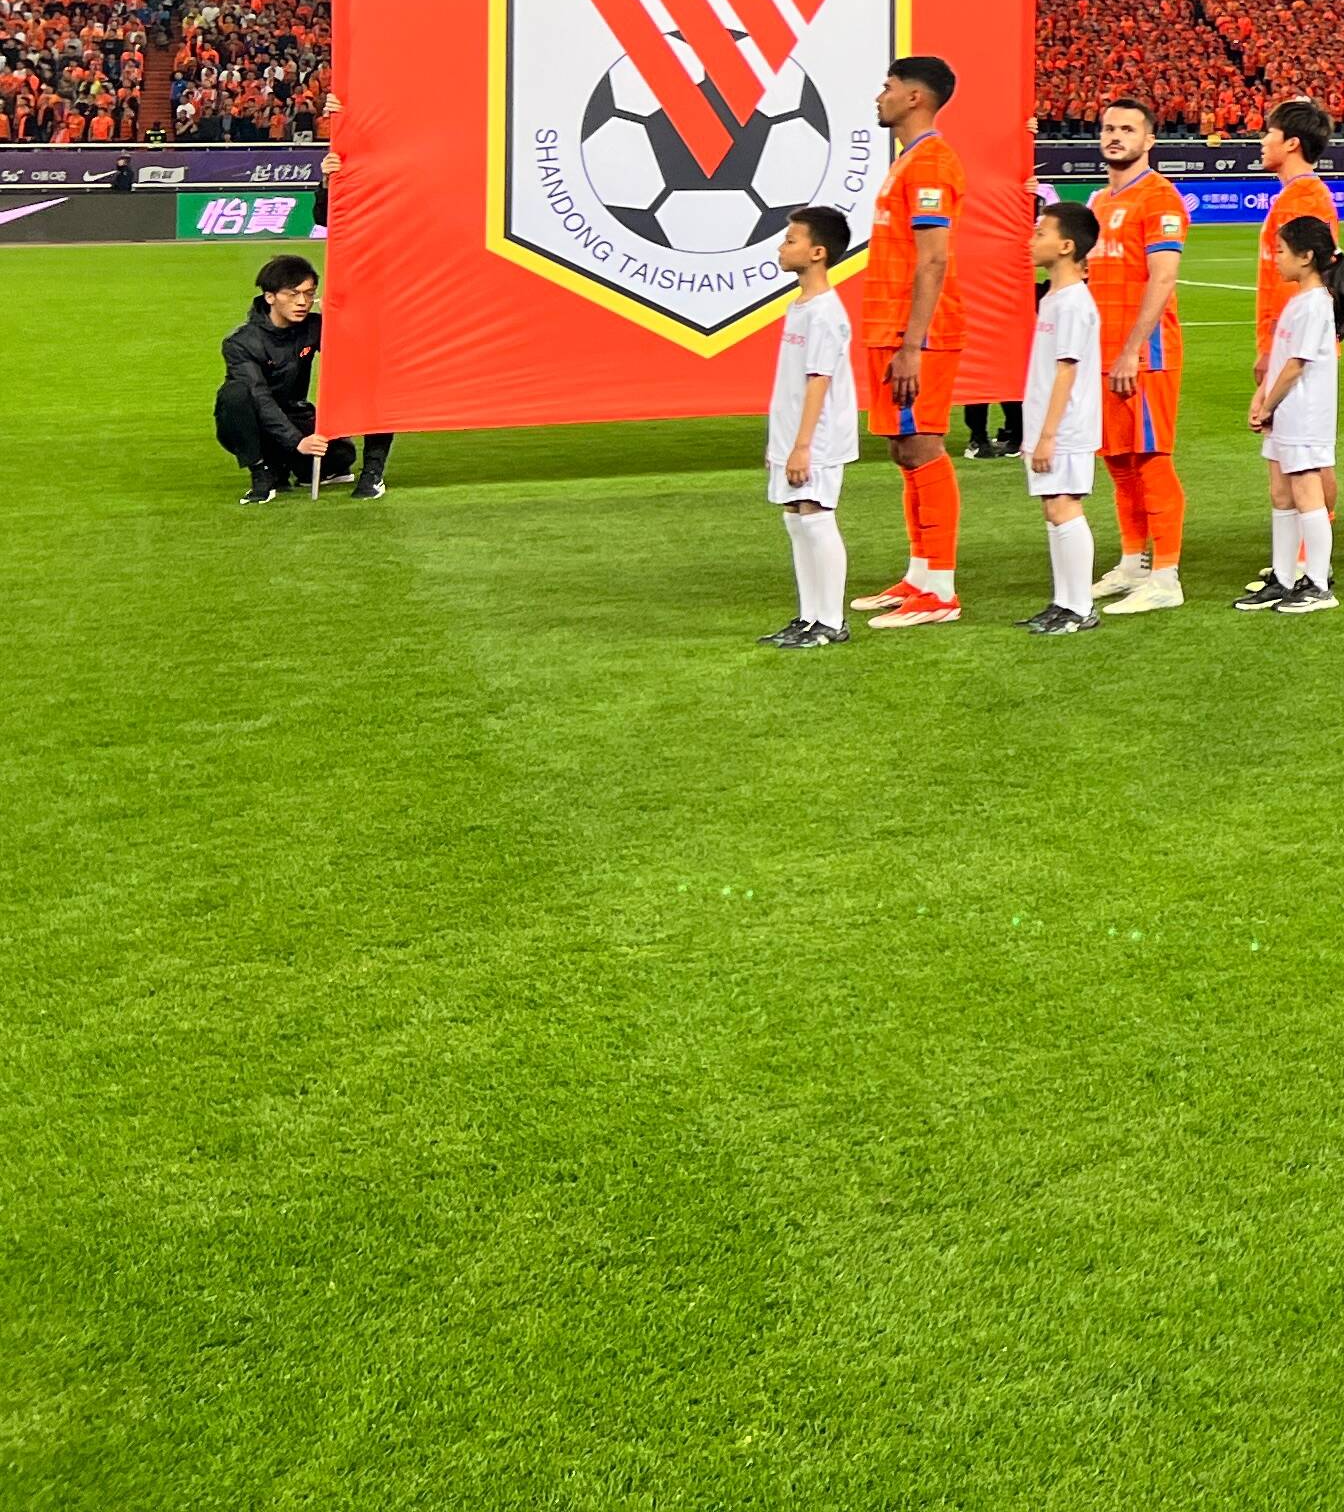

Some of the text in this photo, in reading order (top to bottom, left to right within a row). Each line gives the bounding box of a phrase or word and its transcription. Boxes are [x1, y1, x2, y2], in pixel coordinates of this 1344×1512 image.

[843, 127, 872, 192] CLUB
[197, 197, 297, 235] 怡寶
[535, 127, 736, 293] SHANDONG TAISHAN
